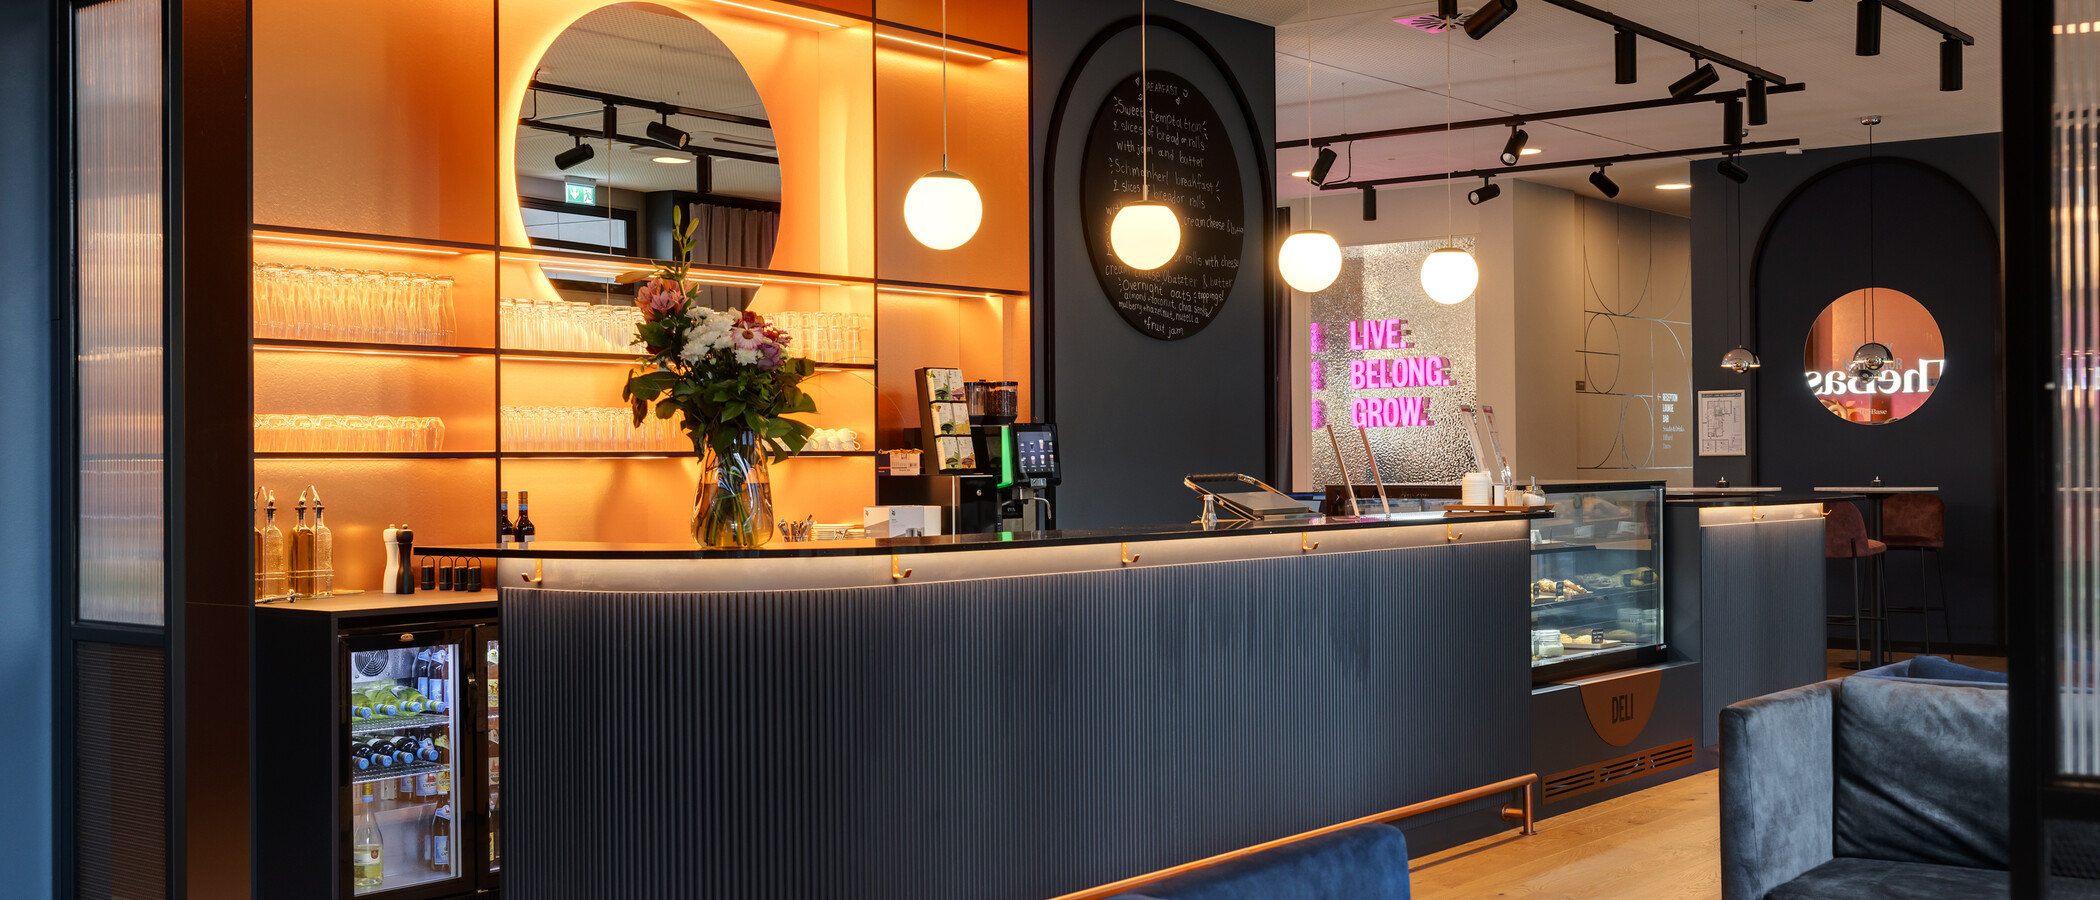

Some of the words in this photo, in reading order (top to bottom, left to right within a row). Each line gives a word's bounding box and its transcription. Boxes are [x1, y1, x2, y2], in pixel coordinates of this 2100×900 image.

[1149, 108, 1203, 133] temptation
[1120, 120, 1144, 136] slices
[1148, 124, 1155, 137] of
[1156, 126, 1180, 146] bread
[1188, 136, 1206, 151] rolls
[1116, 140, 1135, 154] with
[1157, 148, 1175, 161] and
[1179, 152, 1205, 168] butter
[1122, 179, 1141, 194] slices
[1189, 196, 1206, 210] rolls
[1175, 171, 1214, 195] breakfast
[1185, 251, 1203, 267] rolls
[1204, 254, 1219, 268] with
[1220, 255, 1240, 268] cheese
[1122, 279, 1163, 297] Overnight
[1170, 289, 1192, 302] oats
[1209, 275, 1233, 288] butter
[1167, 325, 1184, 339] jam
[1349, 318, 1408, 351] LIVE.
[1350, 355, 1450, 390] BELONG.
[1351, 396, 1429, 429] GROW.
[1611, 693, 1634, 724] DELI
